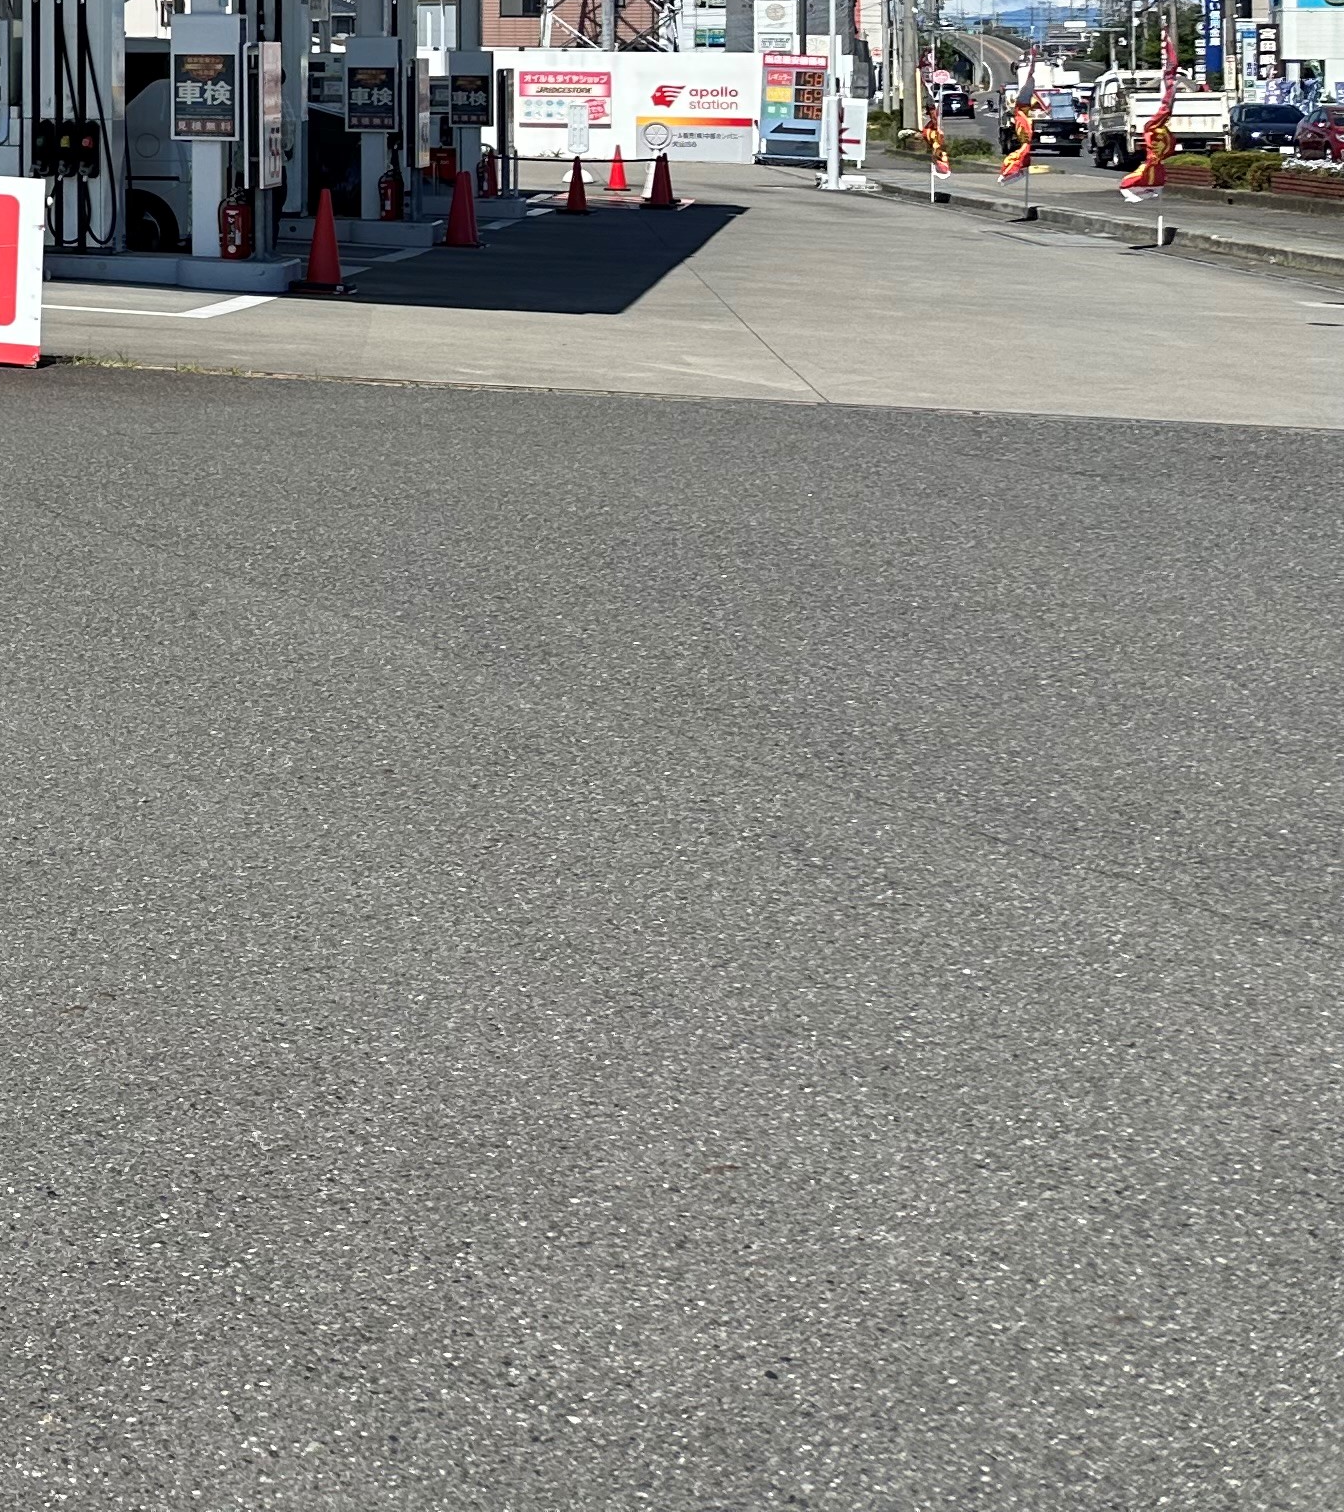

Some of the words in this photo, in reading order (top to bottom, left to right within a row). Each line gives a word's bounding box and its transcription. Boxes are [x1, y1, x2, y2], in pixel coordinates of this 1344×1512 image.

[523, 73, 609, 85] オイル&タイヤショップ
[800, 71, 824, 87] 158
[176, 80, 233, 106] 車検
[349, 87, 394, 106] 車検
[451, 90, 488, 106] 車検
[688, 86, 739, 98] apollo
[688, 99, 739, 111] station
